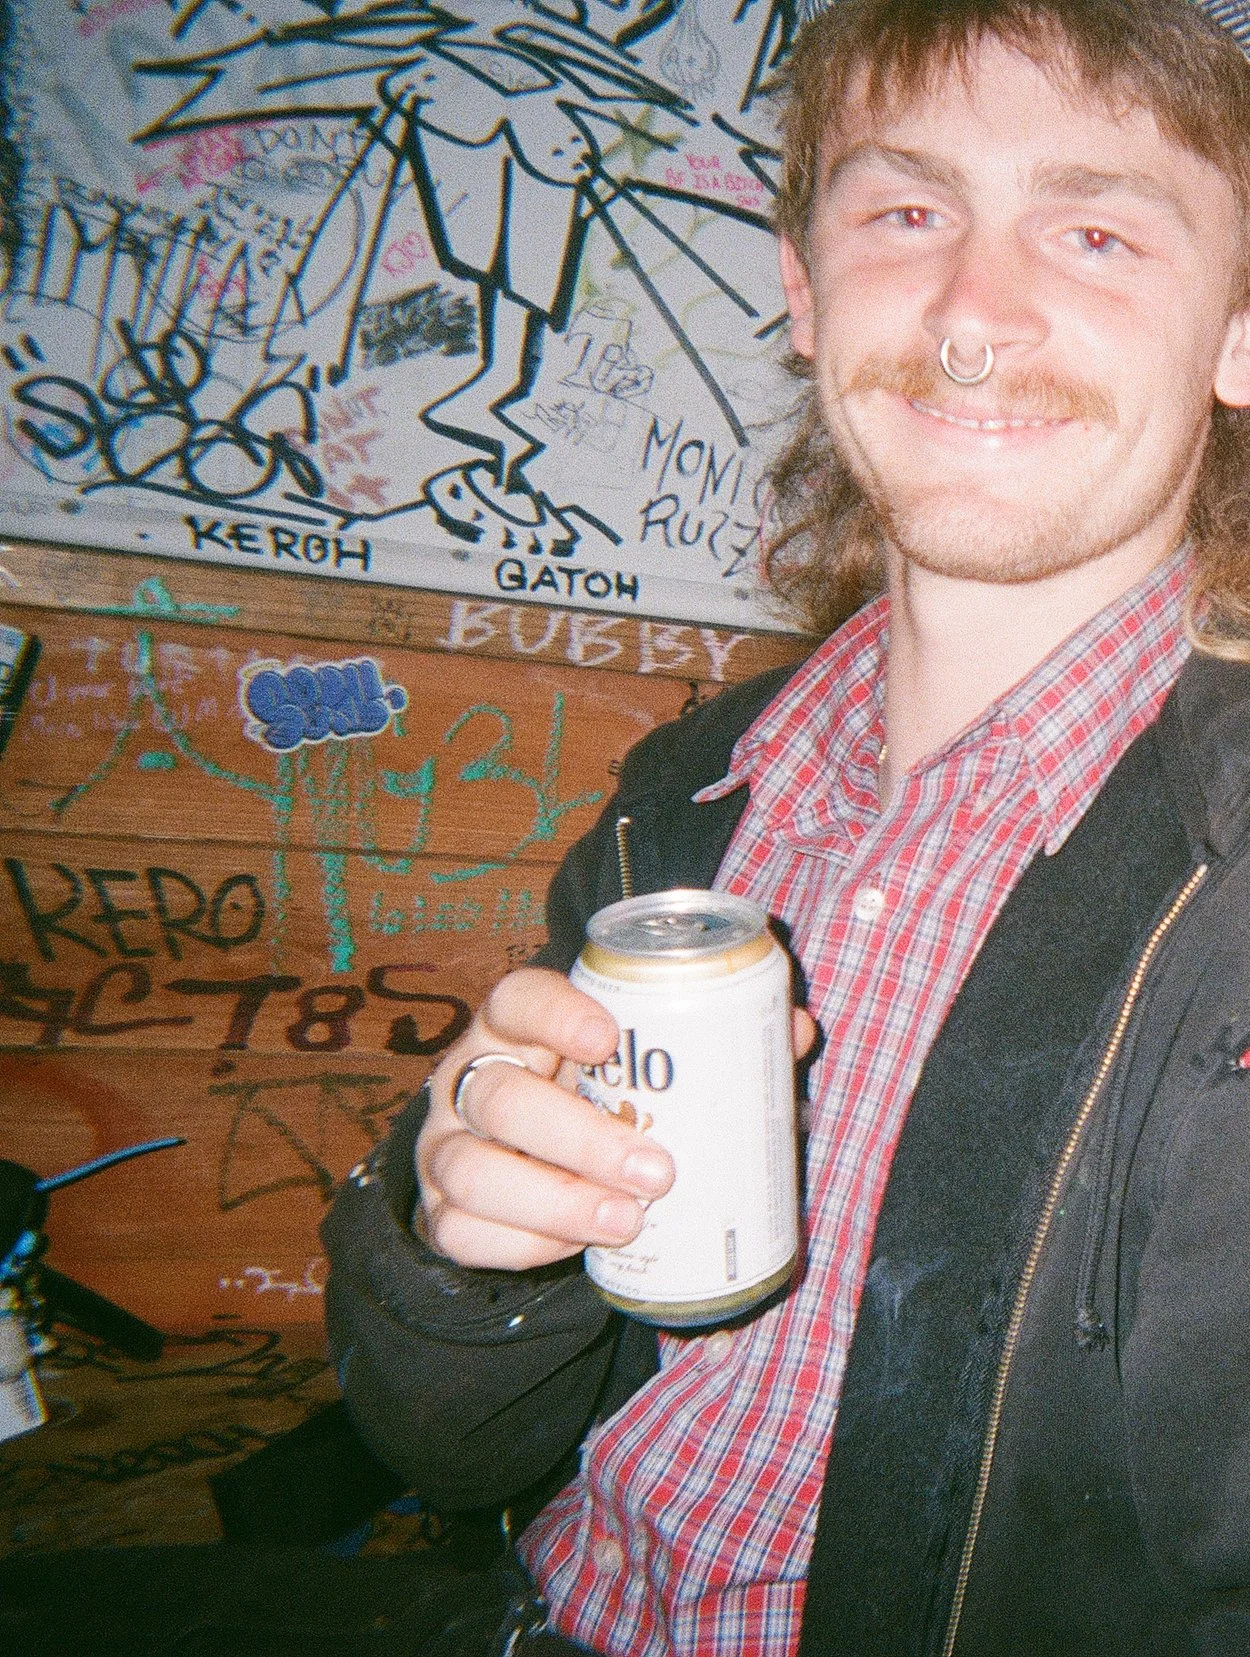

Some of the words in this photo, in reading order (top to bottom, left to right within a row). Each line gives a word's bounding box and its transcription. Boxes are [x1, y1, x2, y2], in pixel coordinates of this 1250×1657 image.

[183, 514, 372, 572] KEROH
[495, 557, 640, 601] GATOH
[437, 599, 753, 682] BUBBY
[5, 857, 266, 962] KERO
[580, 1027, 675, 1092] elo
